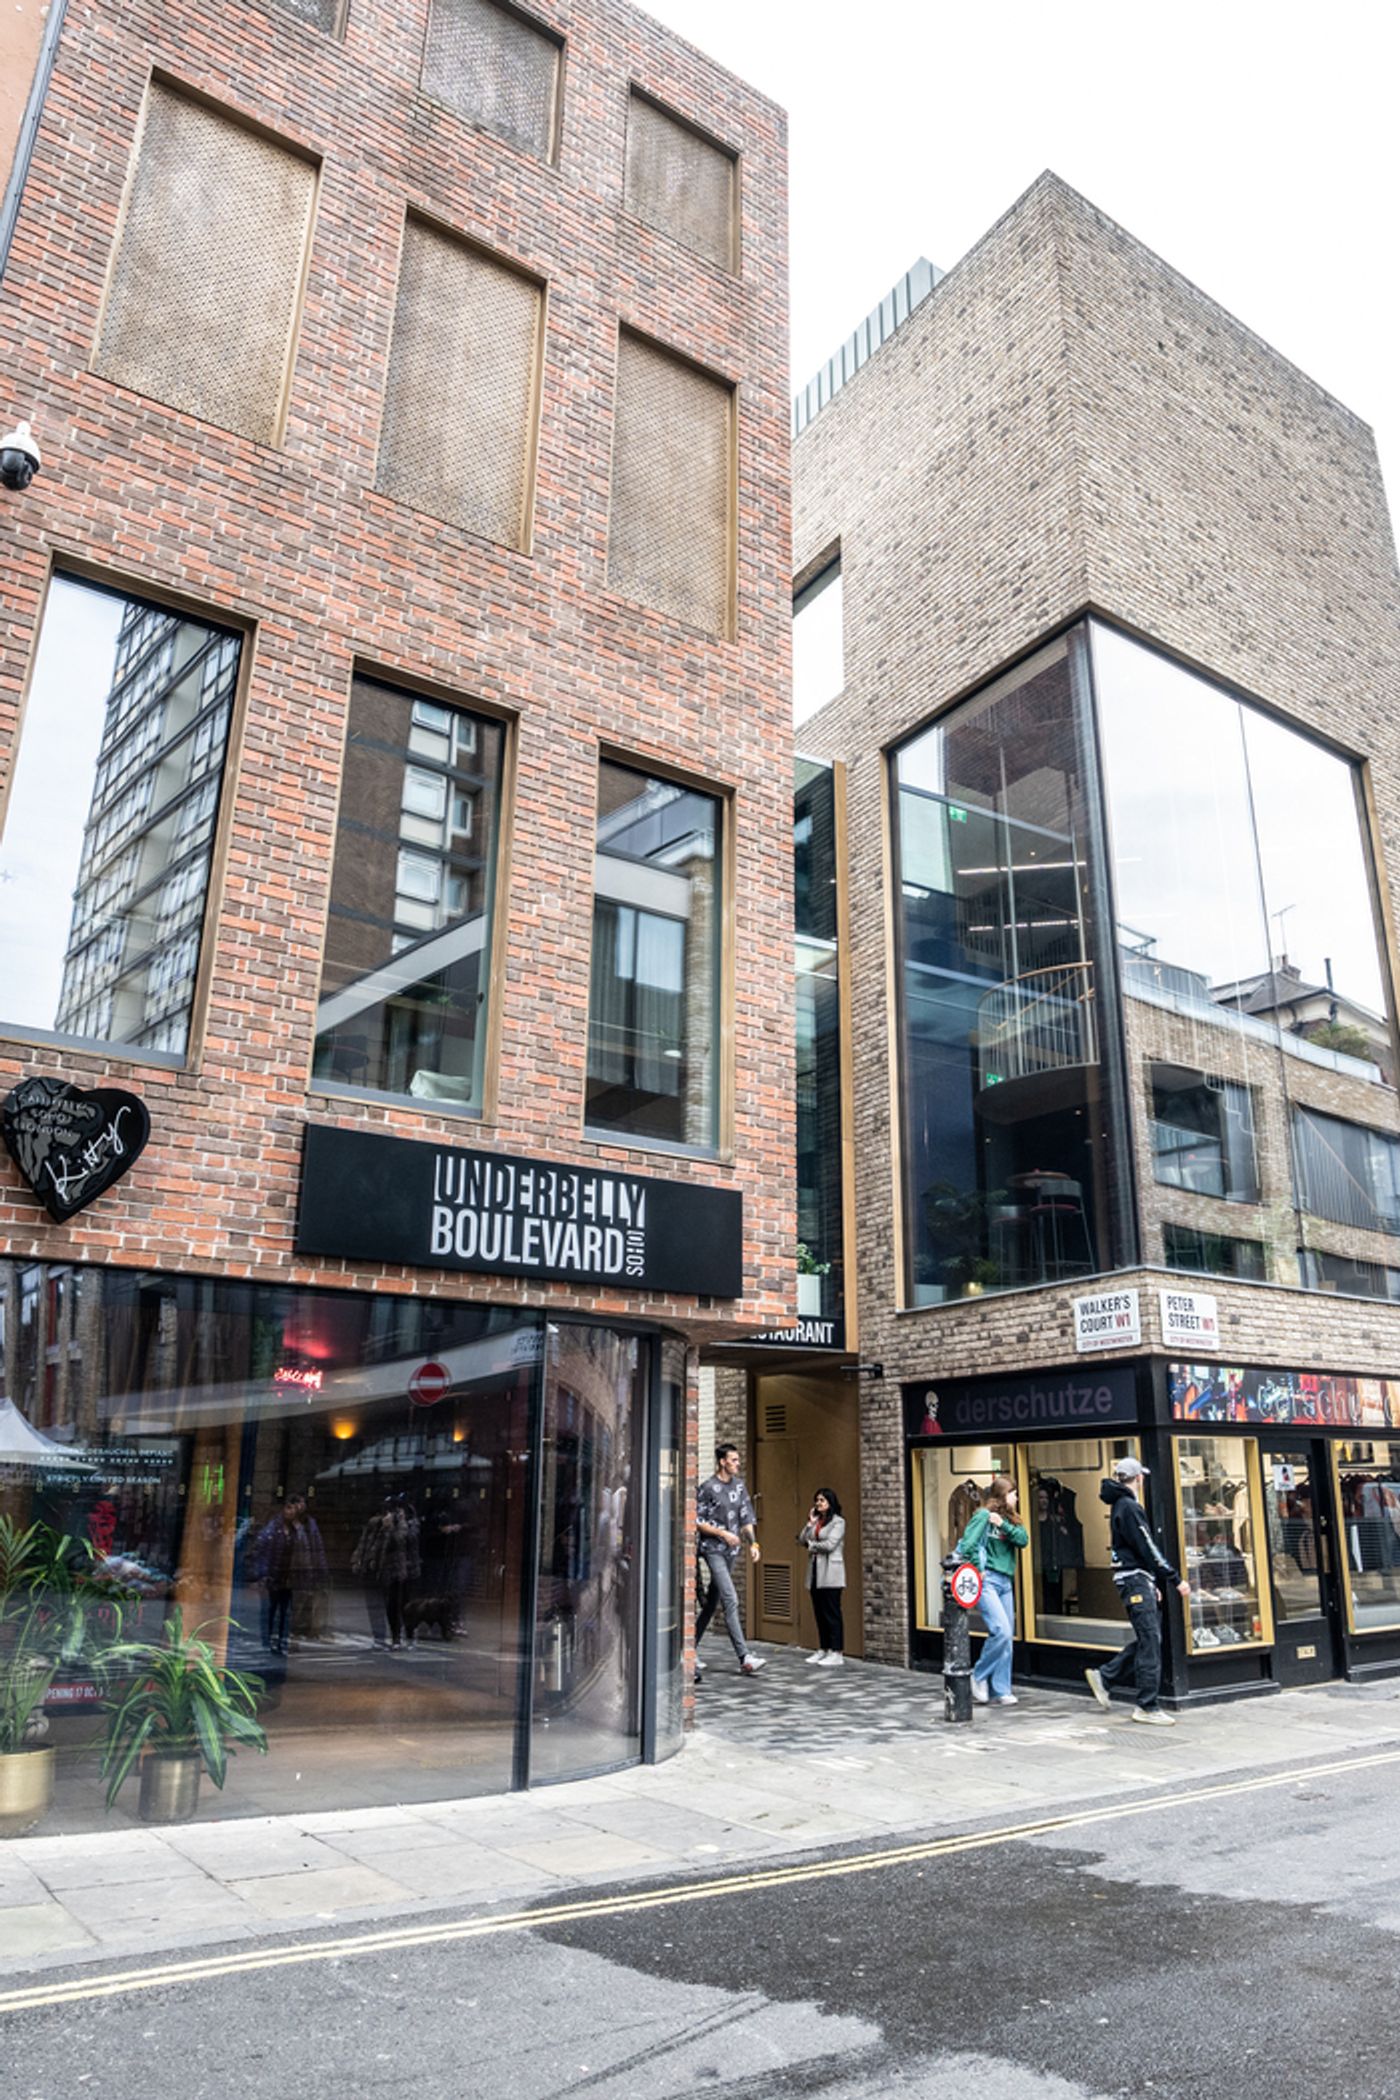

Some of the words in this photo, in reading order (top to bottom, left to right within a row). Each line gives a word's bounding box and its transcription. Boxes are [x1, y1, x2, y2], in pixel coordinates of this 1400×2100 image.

[434, 1154, 646, 1228] UNDERBELLY
[430, 1205, 624, 1274] BOULEVARD
[625, 1229, 646, 1278] SOHO
[1079, 1294, 1131, 1315] WALKER'S
[1167, 1295, 1195, 1312] PETER
[1080, 1314, 1113, 1334] COURT
[1115, 1313, 1131, 1328] W1
[1168, 1313, 1200, 1331] STREET
[1202, 1317, 1215, 1331] W1
[955, 1382, 1113, 1424] derschutze
[47, 1686, 73, 1699] PENING
